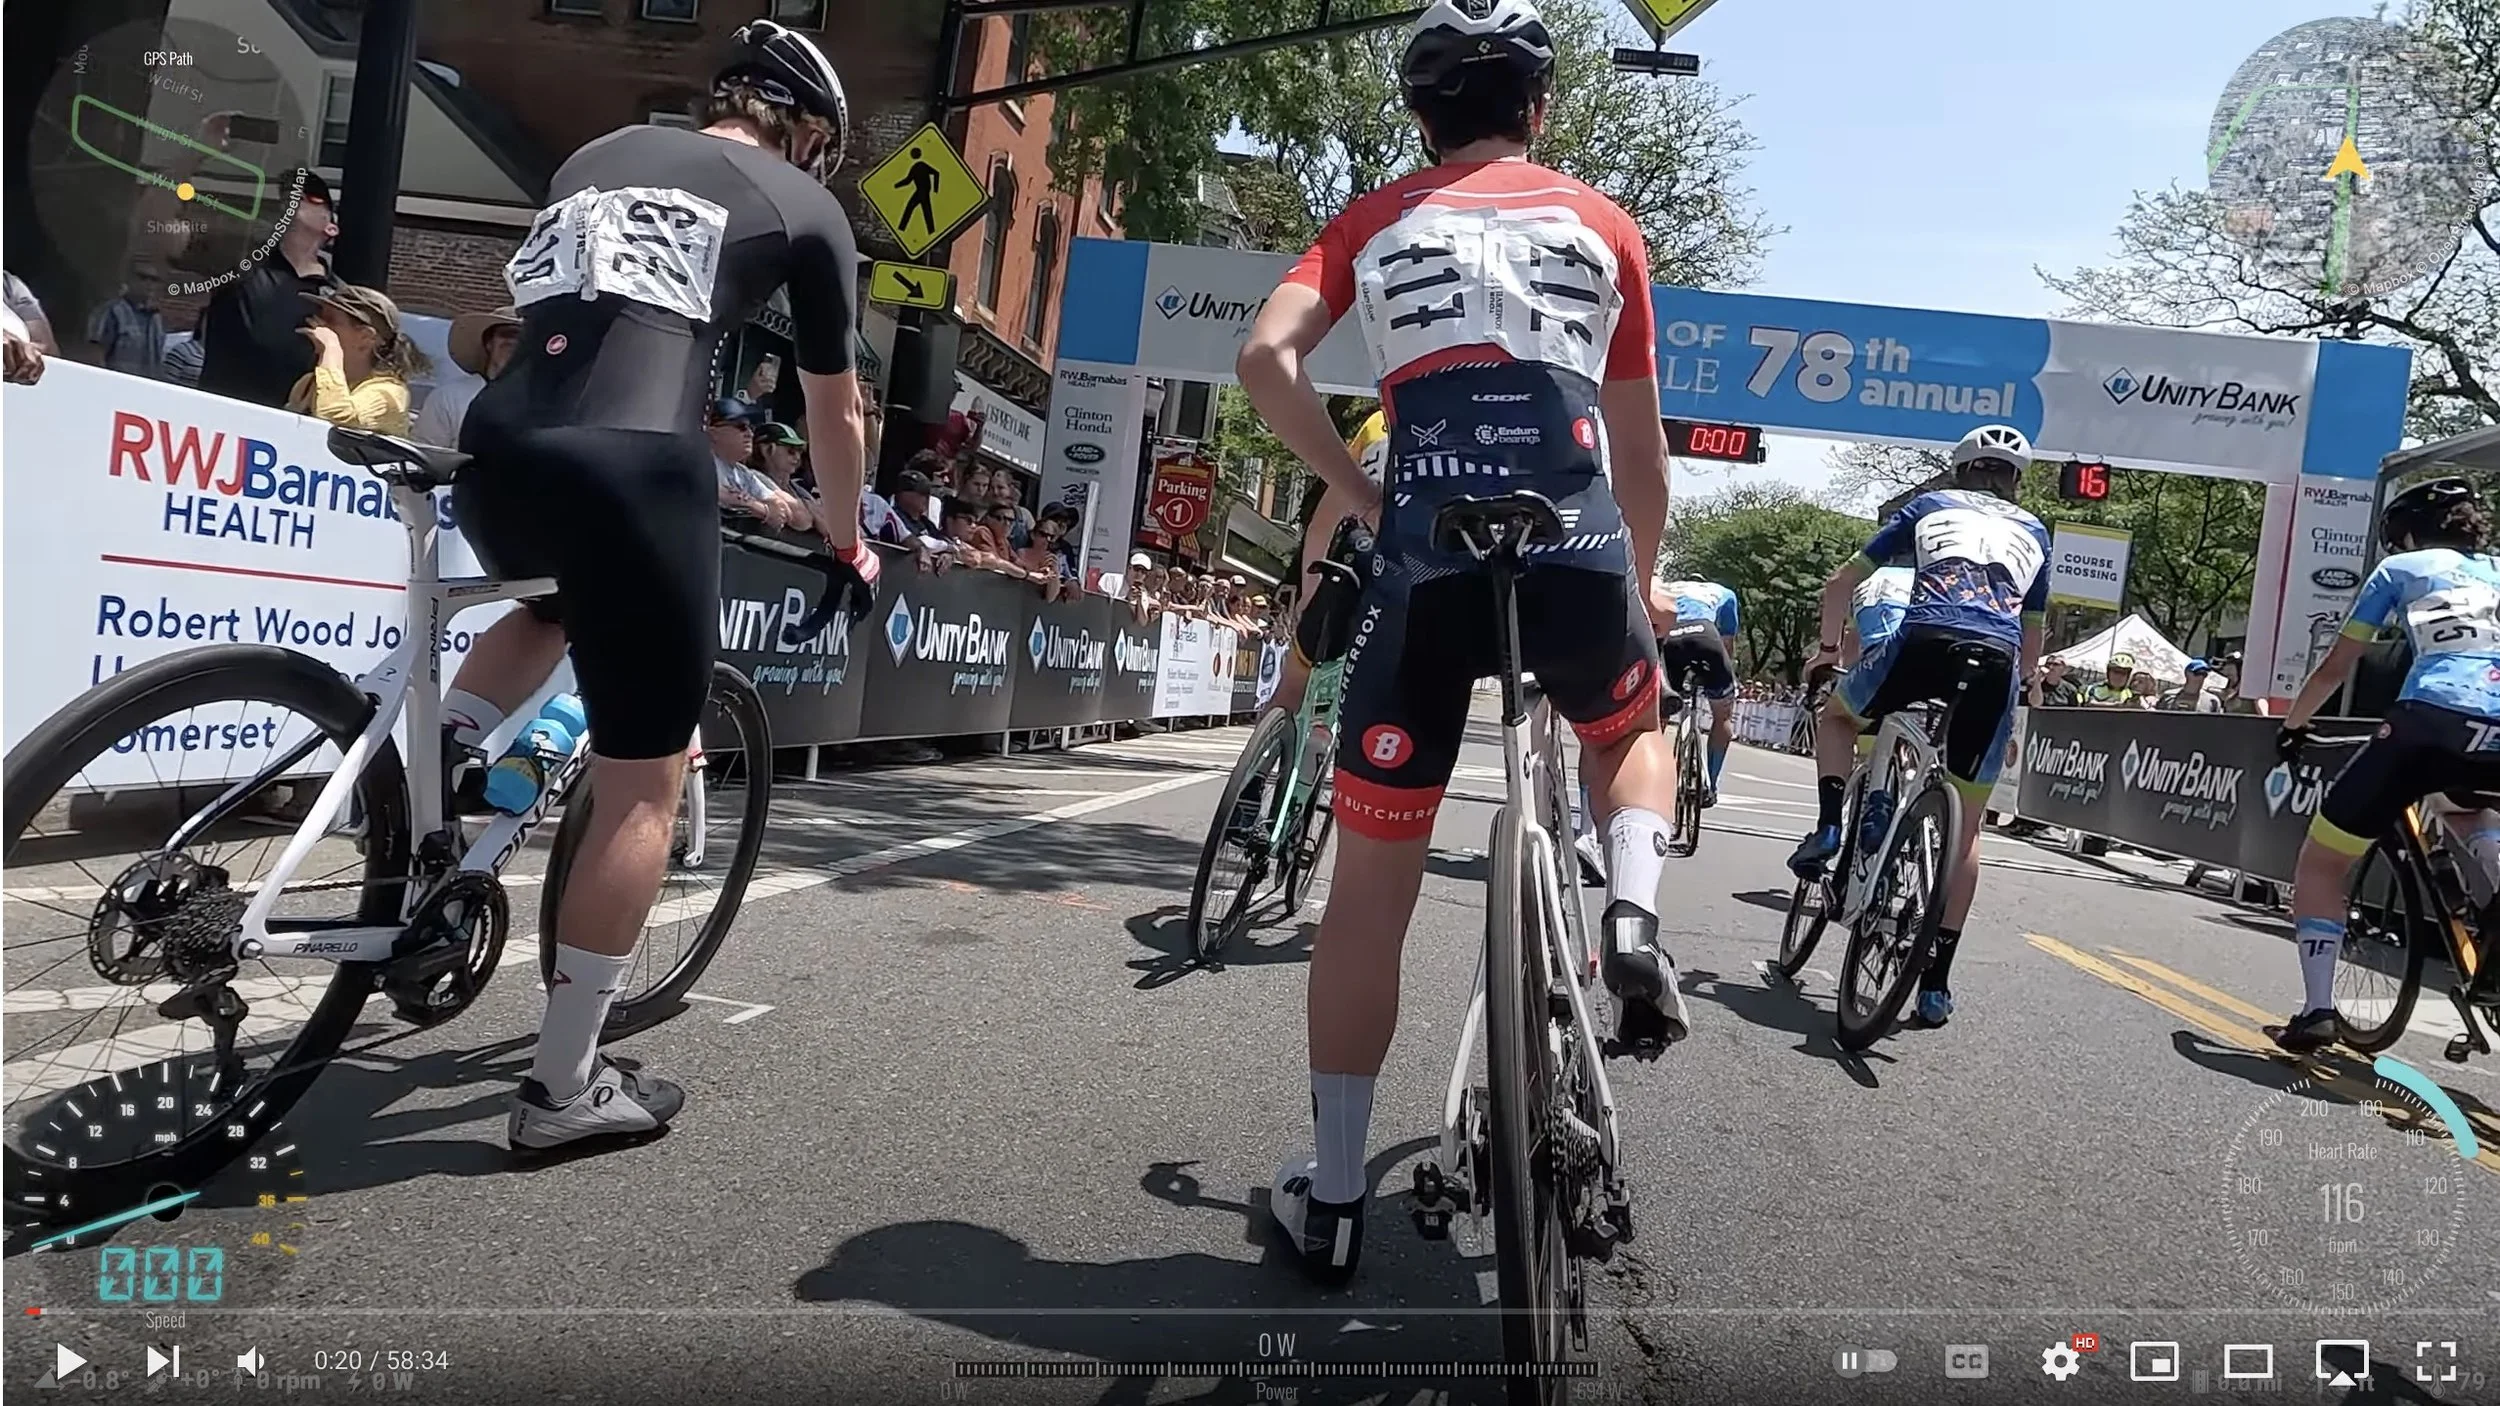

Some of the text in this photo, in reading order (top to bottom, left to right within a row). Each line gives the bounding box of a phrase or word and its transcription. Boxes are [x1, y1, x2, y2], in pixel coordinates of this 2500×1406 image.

[1667, 320, 1727, 349] OF
[1746, 325, 1910, 403] 78 th
[1060, 370, 1127, 386] RWJBarnabas
[1471, 393, 1532, 402] LOOK
[1859, 378, 2014, 418] annual
[1065, 406, 1112, 423] Clinton
[1065, 419, 1112, 434] Honda
[1498, 427, 1539, 436] Enduro
[1498, 434, 1541, 445] bearings
[1689, 427, 1748, 457] 0:00
[1158, 479, 1207, 501] Parking
[2079, 466, 2108, 498] 16
[163, 492, 314, 550] HEALTH
[1172, 503, 1183, 522] 1
[2064, 553, 2114, 570] COURSE
[2056, 564, 2118, 582] CROSSING
[2320, 570, 2345, 578] LAND
[2321, 578, 2353, 586] ROVER
[96, 595, 241, 643] Robert
[255, 606, 354, 648] Wood
[428, 597, 439, 683] PRINCE
[752, 660, 799, 696] growing
[802, 657, 824, 682] with
[112, 717, 276, 754] omerset
[1373, 732, 1401, 761] B
[1345, 796, 1438, 822] BUTCHERB
[293, 941, 358, 954] PINARELLO
